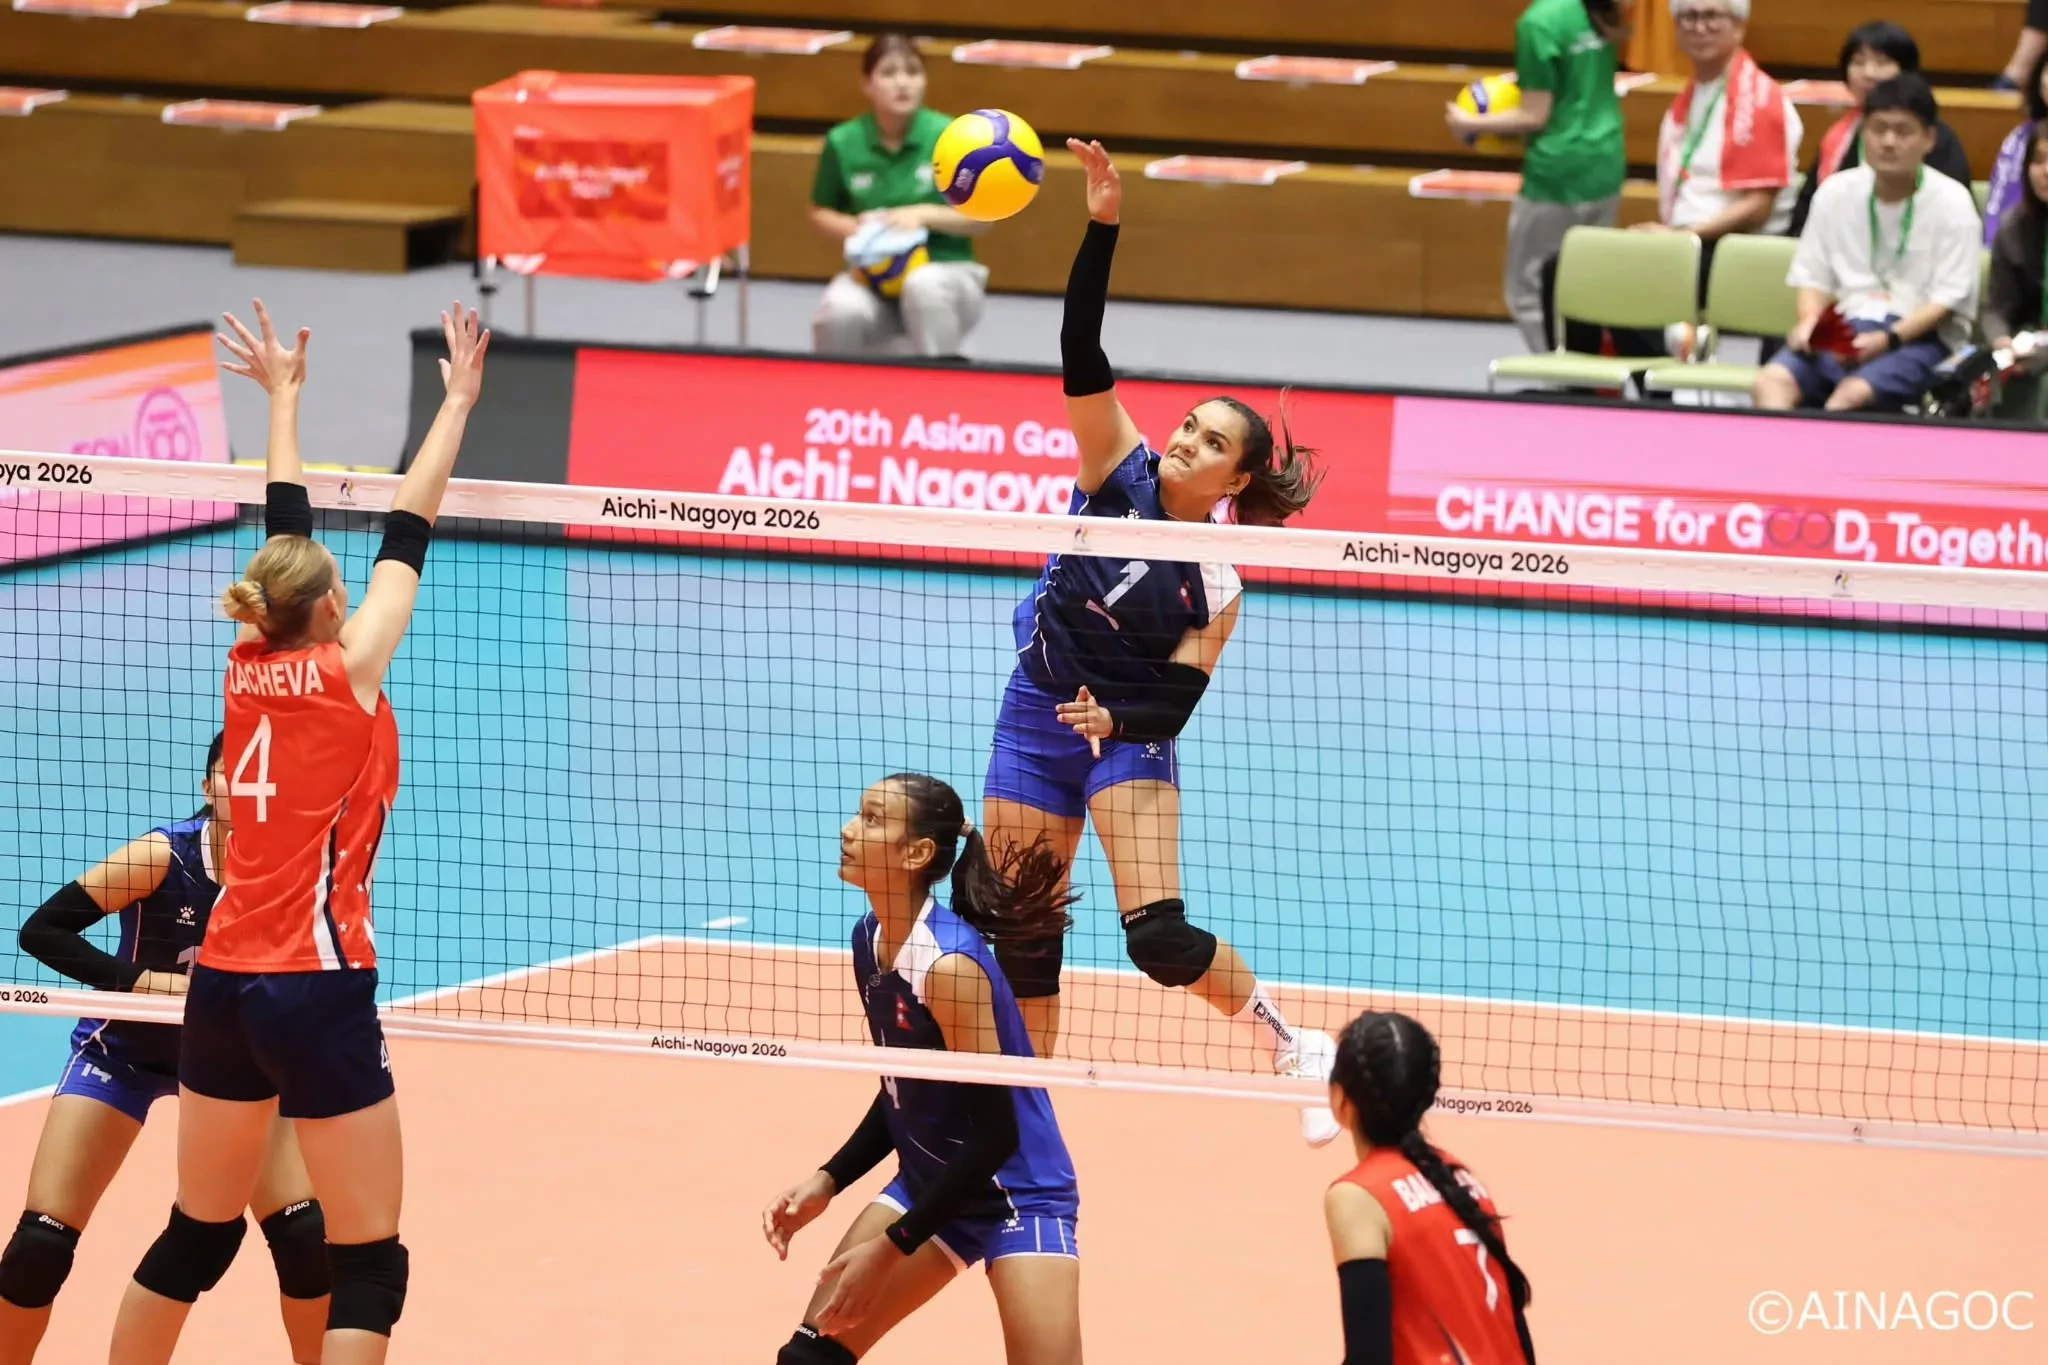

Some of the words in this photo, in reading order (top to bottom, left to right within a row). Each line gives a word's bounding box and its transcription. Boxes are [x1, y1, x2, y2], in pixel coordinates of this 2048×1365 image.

[804, 408, 891, 447] 20th
[901, 413, 1004, 454] Asian
[38, 462, 92, 484] 2026
[718, 443, 1077, 514] Aichi-Nagoya
[601, 497, 756, 530] Aichi-Nagoya
[764, 508, 820, 530] 2026
[1436, 486, 1641, 541] CHANGE
[1652, 499, 1716, 545] for
[1725, 502, 1877, 562] GOOD,
[1887, 512, 2048, 567] Togeth
[1342, 541, 1503, 575] Aichi-Nagoya
[1510, 552, 1569, 575] 2026
[231, 714, 276, 822] 4
[14, 990, 48, 1004] 2026
[380, 1039, 391, 1073] 4
[651, 1035, 748, 1057] Aichi-Nagoya
[752, 1043, 787, 1057] 2026
[1497, 1100, 1533, 1114] 2026
[1454, 1228, 1498, 1313] 7
